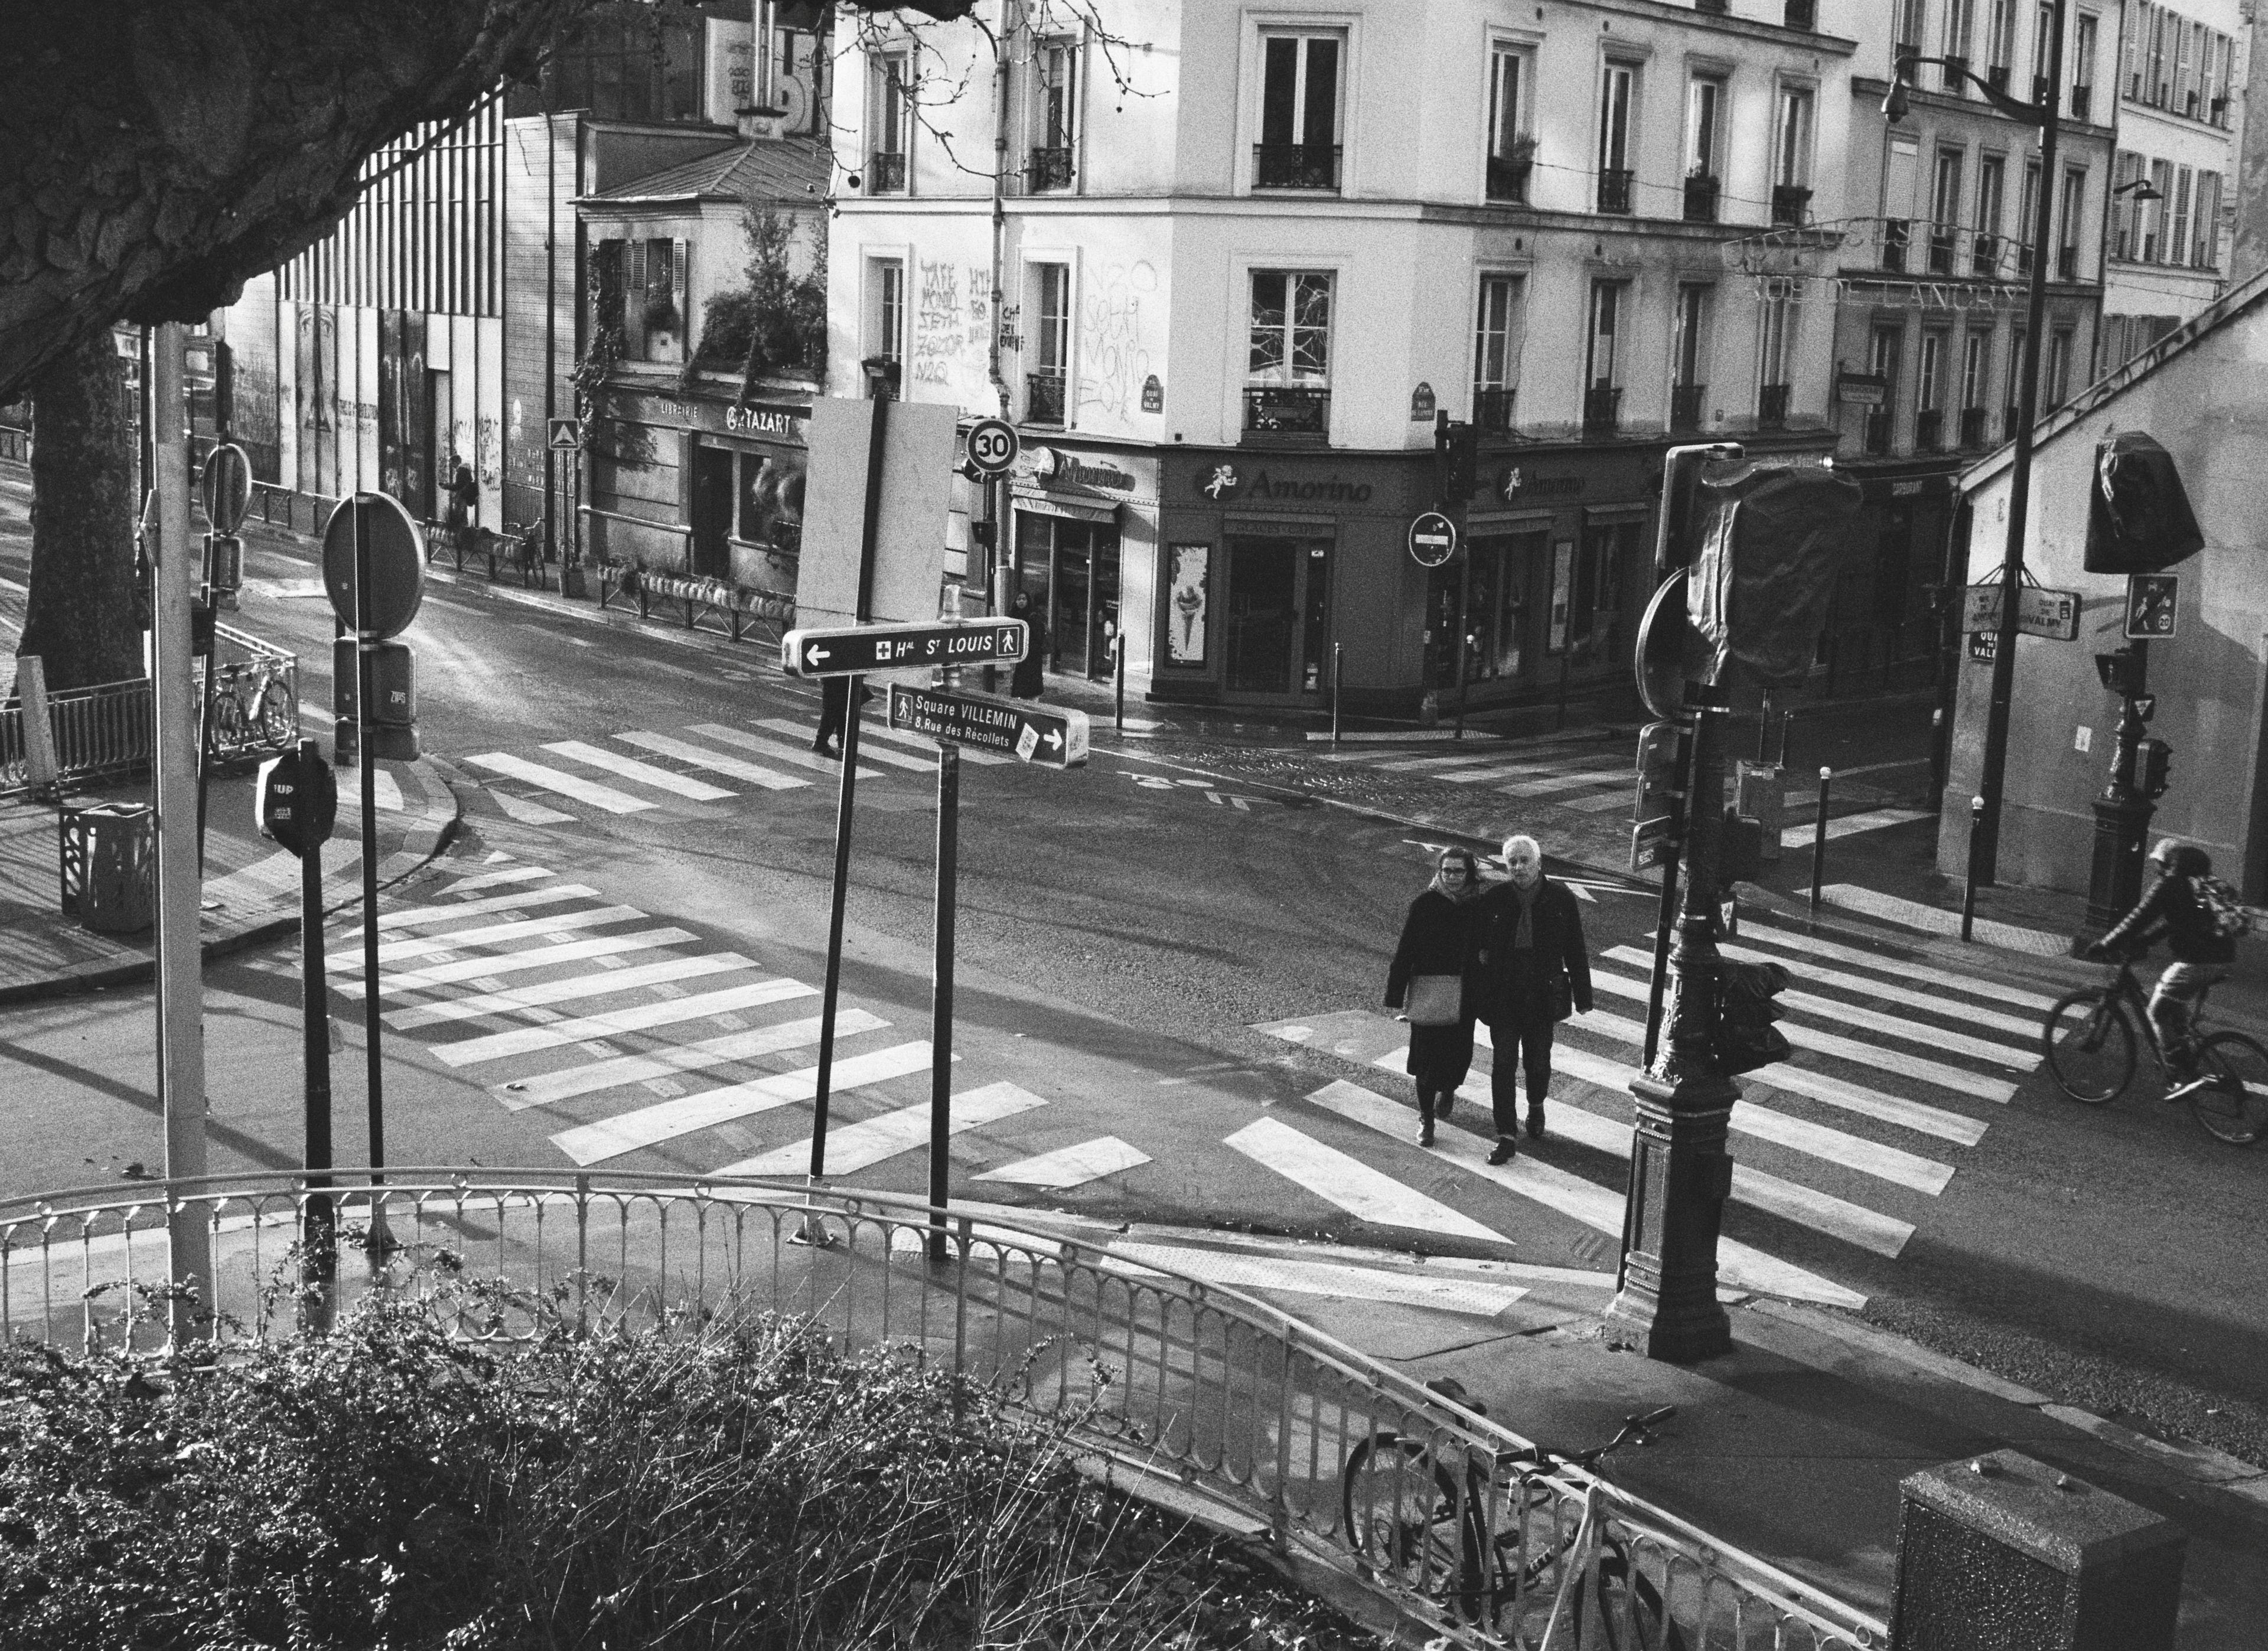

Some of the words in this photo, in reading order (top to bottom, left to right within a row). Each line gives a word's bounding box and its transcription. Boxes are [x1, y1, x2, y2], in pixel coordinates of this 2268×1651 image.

[661, 403, 698, 417] LIBRAIRIE
[978, 435, 1008, 457] 30
[1247, 469, 1371, 502] Amorino
[2029, 615, 2061, 628] VALMY
[2160, 618, 2169, 627] 20
[948, 635, 992, 654] LOUIS
[1980, 632, 1998, 641] QUA
[915, 694, 955, 716] Square
[961, 703, 1017, 730] VILLEMIN
[945, 723, 962, 738] des
[964, 726, 1010, 748] Récollets
